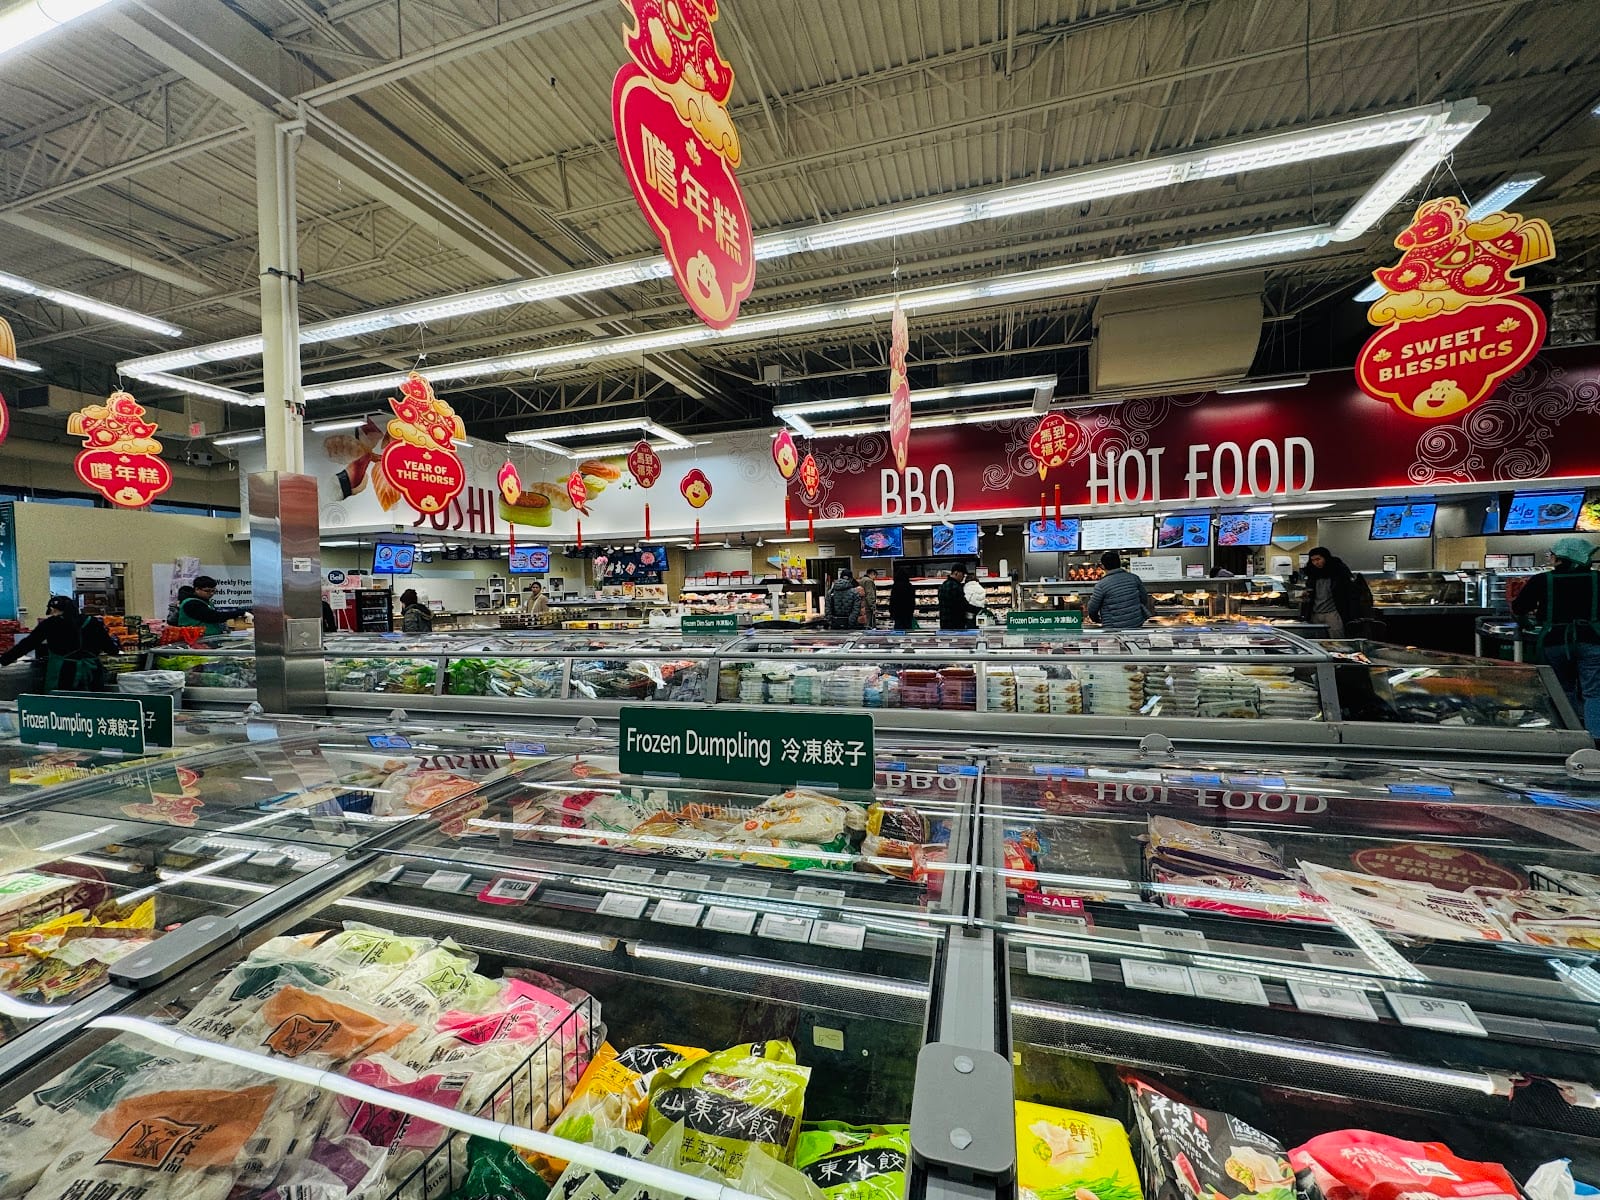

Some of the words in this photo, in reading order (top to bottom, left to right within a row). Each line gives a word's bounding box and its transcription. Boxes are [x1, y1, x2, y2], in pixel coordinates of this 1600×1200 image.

[1400, 325, 1486, 360] SWEET
[1378, 339, 1514, 383] BLESSINGS
[396, 469, 419, 481] THE
[421, 472, 456, 486] HORSE
[403, 460, 433, 474] YEAR
[434, 465, 448, 476] OF
[1086, 447, 1166, 507] HOT
[1184, 437, 1316, 504] FOOD
[880, 463, 956, 529] BBQ
[329, 573, 344, 582] Bell
[1009, 616, 1028, 625] Frozen
[1028, 616, 1039, 624] Dim
[1039, 616, 1053, 625] Sum
[21, 709, 50, 730] Frozen
[51, 711, 94, 738] Dumpling
[96, 716, 140, 739] 冷凍餃子
[626, 727, 682, 755] Frozen
[685, 729, 772, 767] Dumpling
[780, 737, 868, 768] 冷凍餃子
[1042, 896, 1081, 909] SALE
[807, 1150, 907, 1182] 東水餃
